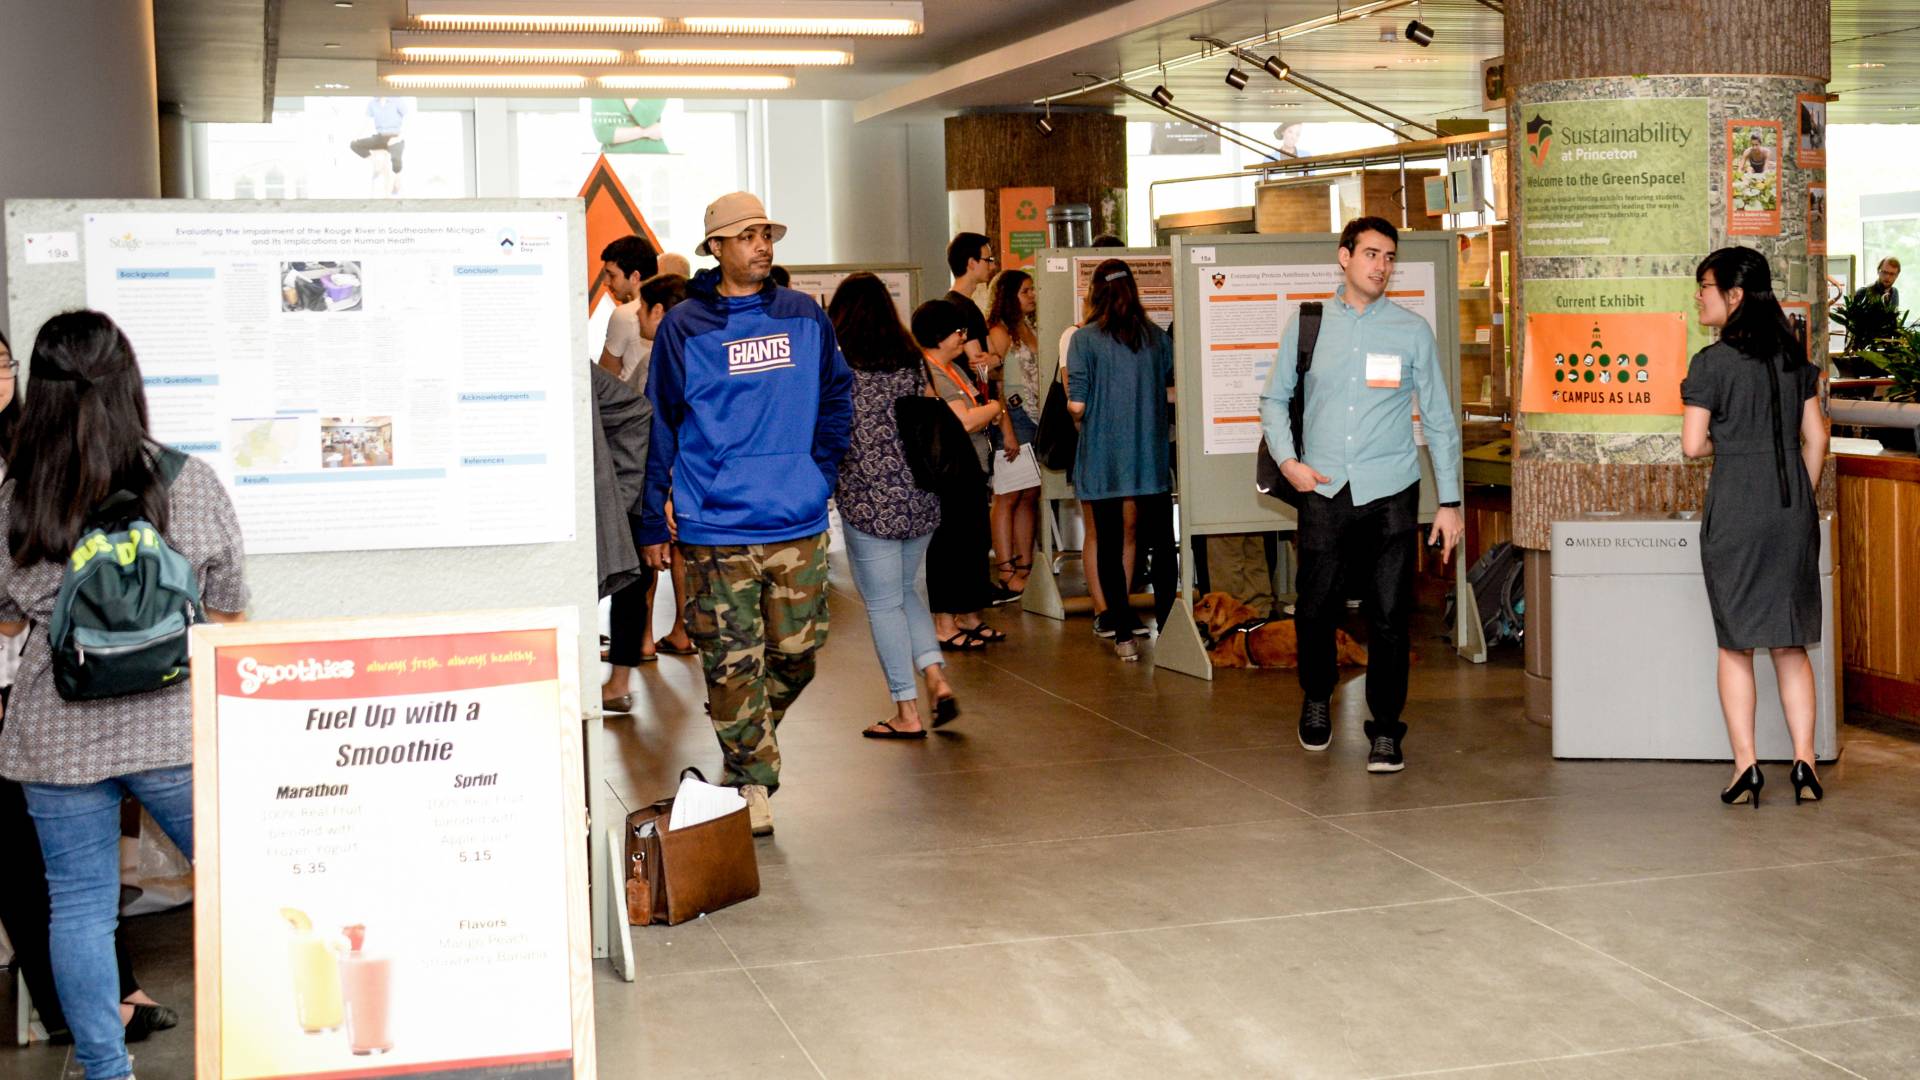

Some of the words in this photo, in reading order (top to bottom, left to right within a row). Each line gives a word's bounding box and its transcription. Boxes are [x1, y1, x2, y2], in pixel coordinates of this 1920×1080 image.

[1561, 122, 1692, 148] Sustainability
[1562, 151, 1572, 162] at
[1576, 148, 1638, 161] Princeton
[1527, 175, 1563, 188] Welcome
[1566, 175, 1577, 186] to
[1580, 174, 1599, 185] the
[1602, 172, 1686, 187] GreenSpace!
[175, 227, 224, 237] Evaluating
[225, 227, 240, 235] the
[296, 227, 305, 235] of
[307, 227, 322, 235] the
[355, 226, 376, 234] River
[378, 226, 386, 234] in
[388, 226, 444, 235] Southeastern
[446, 226, 486, 236] Michigan
[251, 237, 270, 246] and
[340, 237, 351, 245] on
[354, 237, 386, 245] Human
[387, 236, 416, 245] Health
[119, 270, 170, 279] Background
[456, 266, 499, 275] Conclusion
[1556, 295, 1596, 308] Current
[1600, 294, 1645, 308] Exhibit
[729, 337, 791, 365] GIANTS
[163, 376, 203, 385] Questions
[461, 392, 530, 402] Acknowledgments
[1562, 390, 1605, 404] CAMPUS
[1608, 391, 1624, 404] AS
[1628, 391, 1652, 404] LAB
[463, 456, 505, 465] References
[243, 475, 270, 484] Results
[1576, 537, 1612, 548] MIXED
[1615, 537, 1677, 548] RECYCLING
[236, 656, 356, 695] Smoothies
[366, 658, 408, 675] always
[447, 653, 487, 670] always
[305, 705, 358, 731] Fuel
[364, 704, 397, 729] Up
[405, 700, 458, 725] with
[466, 701, 481, 722] a
[336, 738, 454, 768] Smoothie
[454, 772, 499, 790] Sprint
[276, 782, 350, 800] Marathon
[458, 919, 508, 930] Flavors
